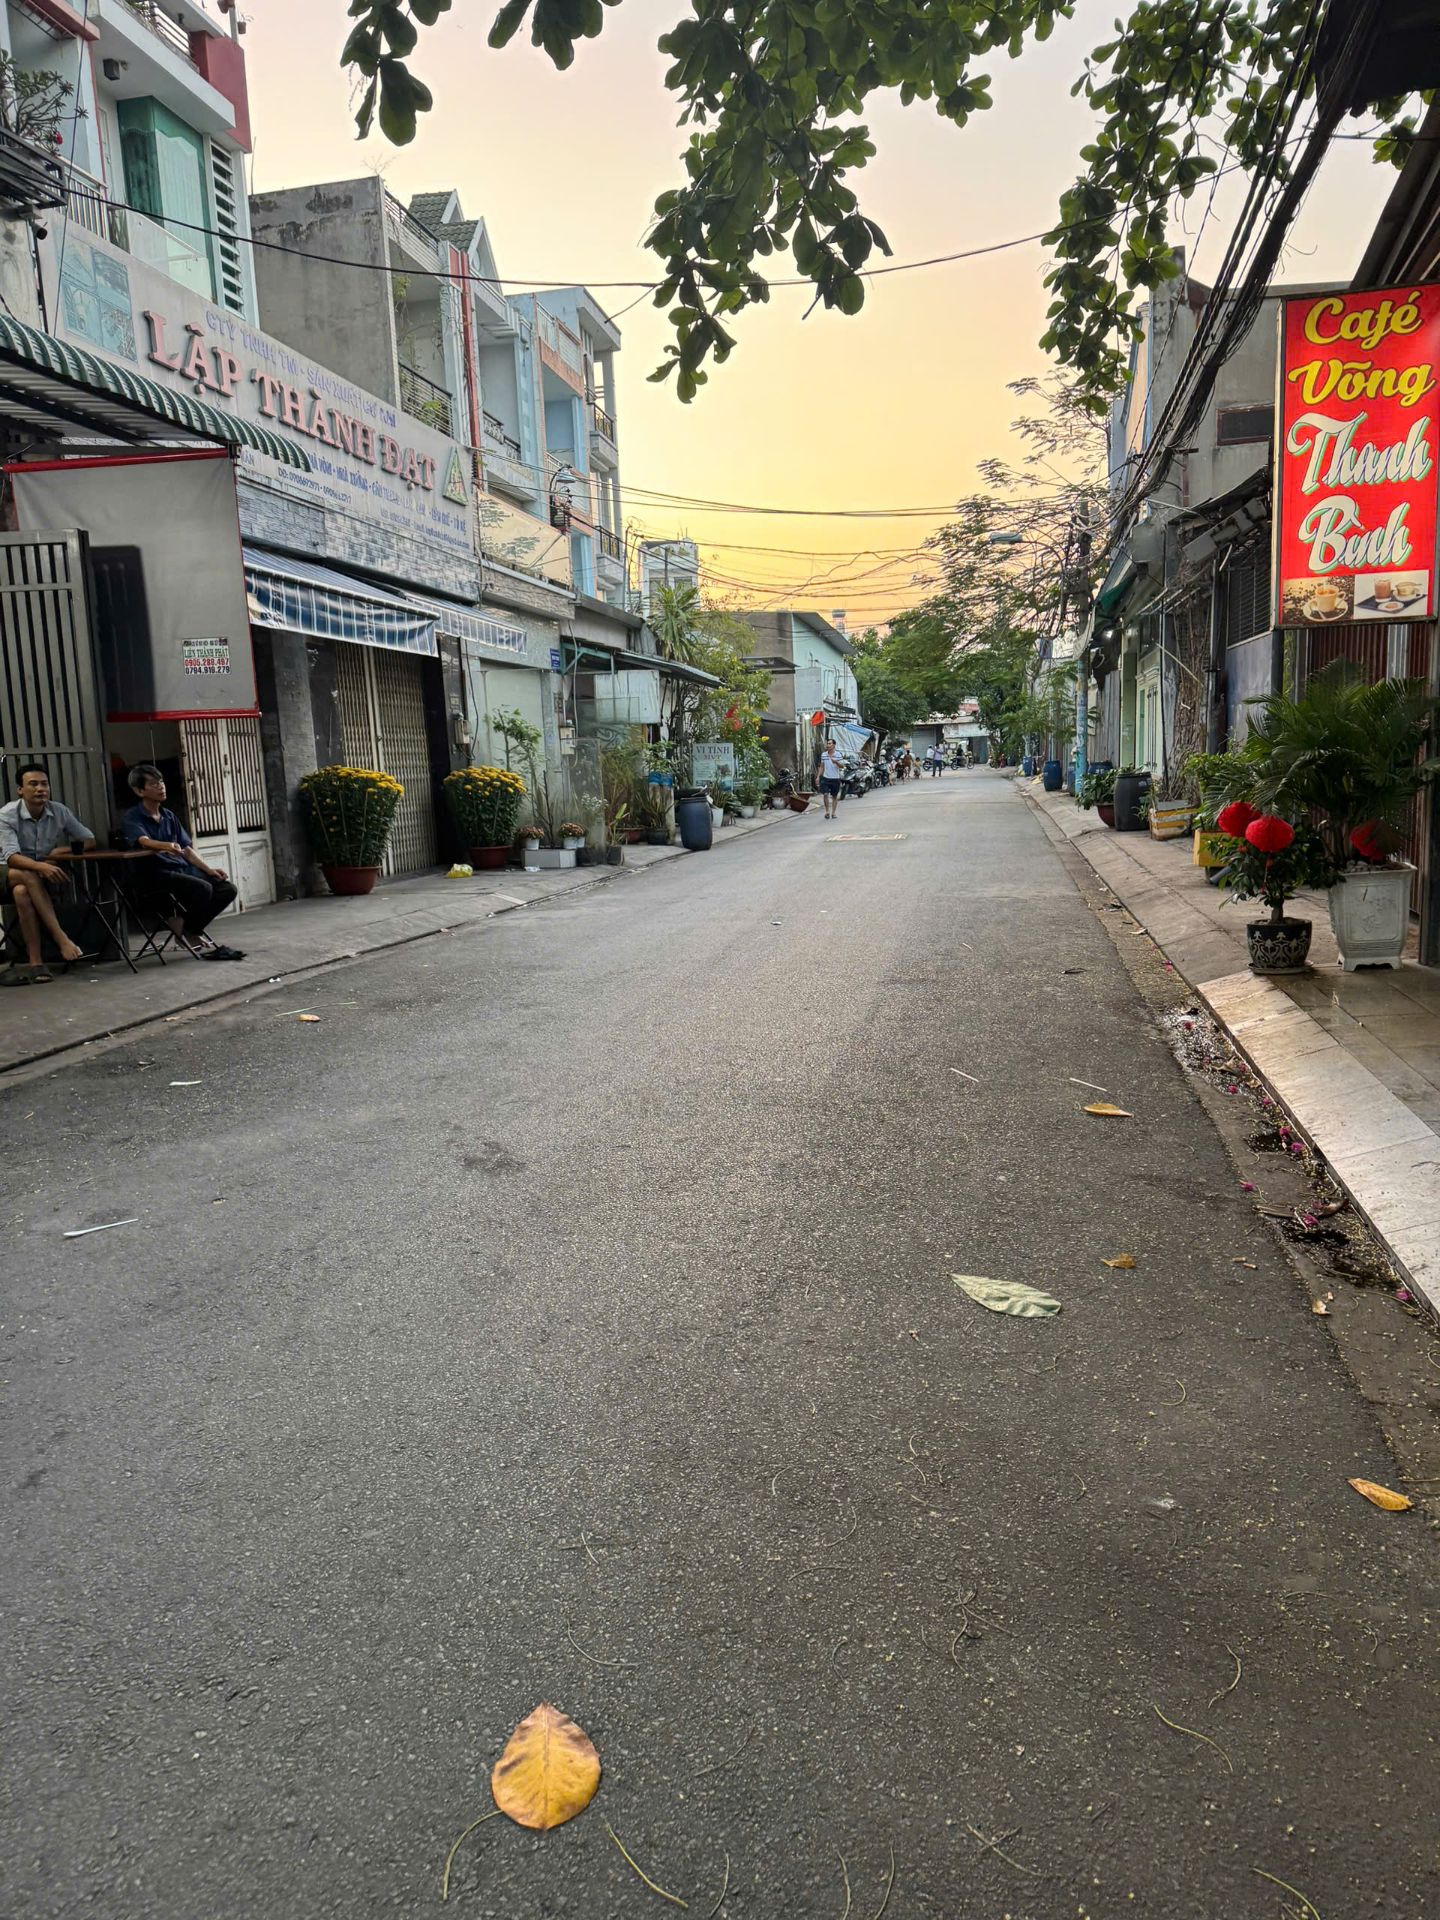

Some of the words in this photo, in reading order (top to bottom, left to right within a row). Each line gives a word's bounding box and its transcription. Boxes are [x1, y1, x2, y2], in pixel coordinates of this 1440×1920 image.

[205, 310, 236, 341] CTY
[1303, 291, 1423, 351] Café
[144, 310, 243, 398] LẬP
[250, 367, 377, 466] THÀNH
[379, 433, 437, 491] ĐẠT
[1287, 357, 1437, 408] Võng
[1285, 410, 1434, 496] Thanh
